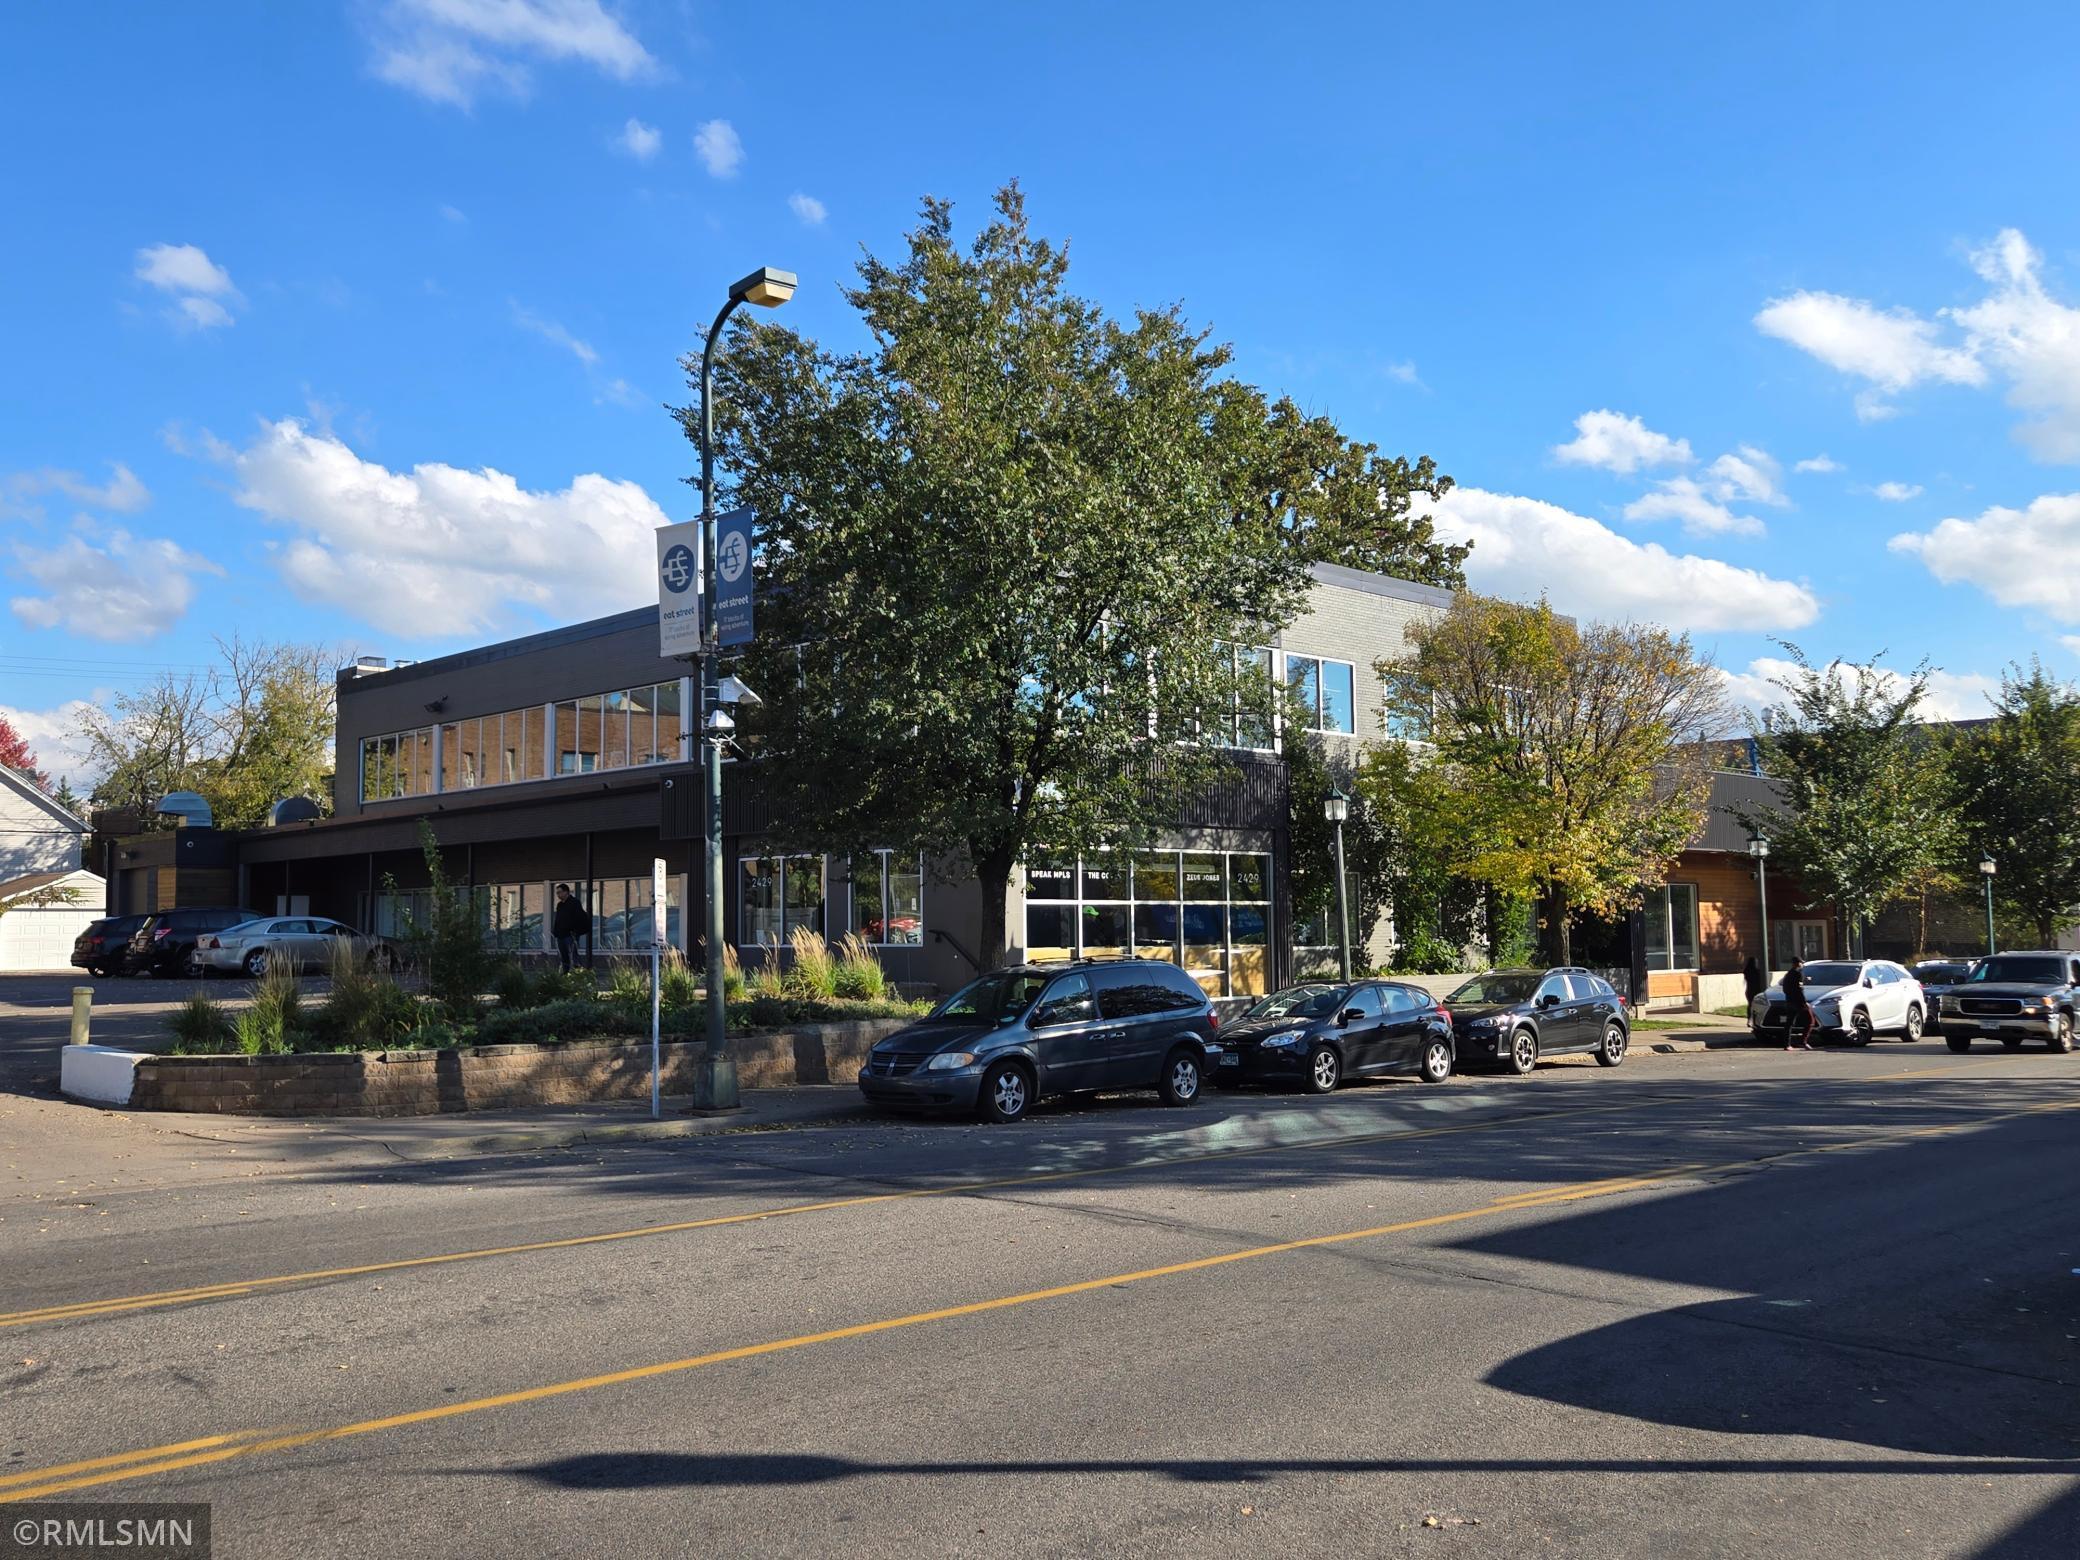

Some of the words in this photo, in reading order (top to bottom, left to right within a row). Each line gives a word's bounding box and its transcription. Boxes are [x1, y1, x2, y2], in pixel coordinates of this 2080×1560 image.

[718, 600, 729, 610] eat
[729, 595, 749, 607] street
[663, 610, 675, 620] eat
[676, 606, 695, 618] street
[1031, 870, 1052, 878] SPEAK
[1053, 870, 1071, 879] MPLS
[1088, 871, 1100, 880] THE
[1237, 873, 1259, 883] 2429
[752, 876, 772, 887] 2429
